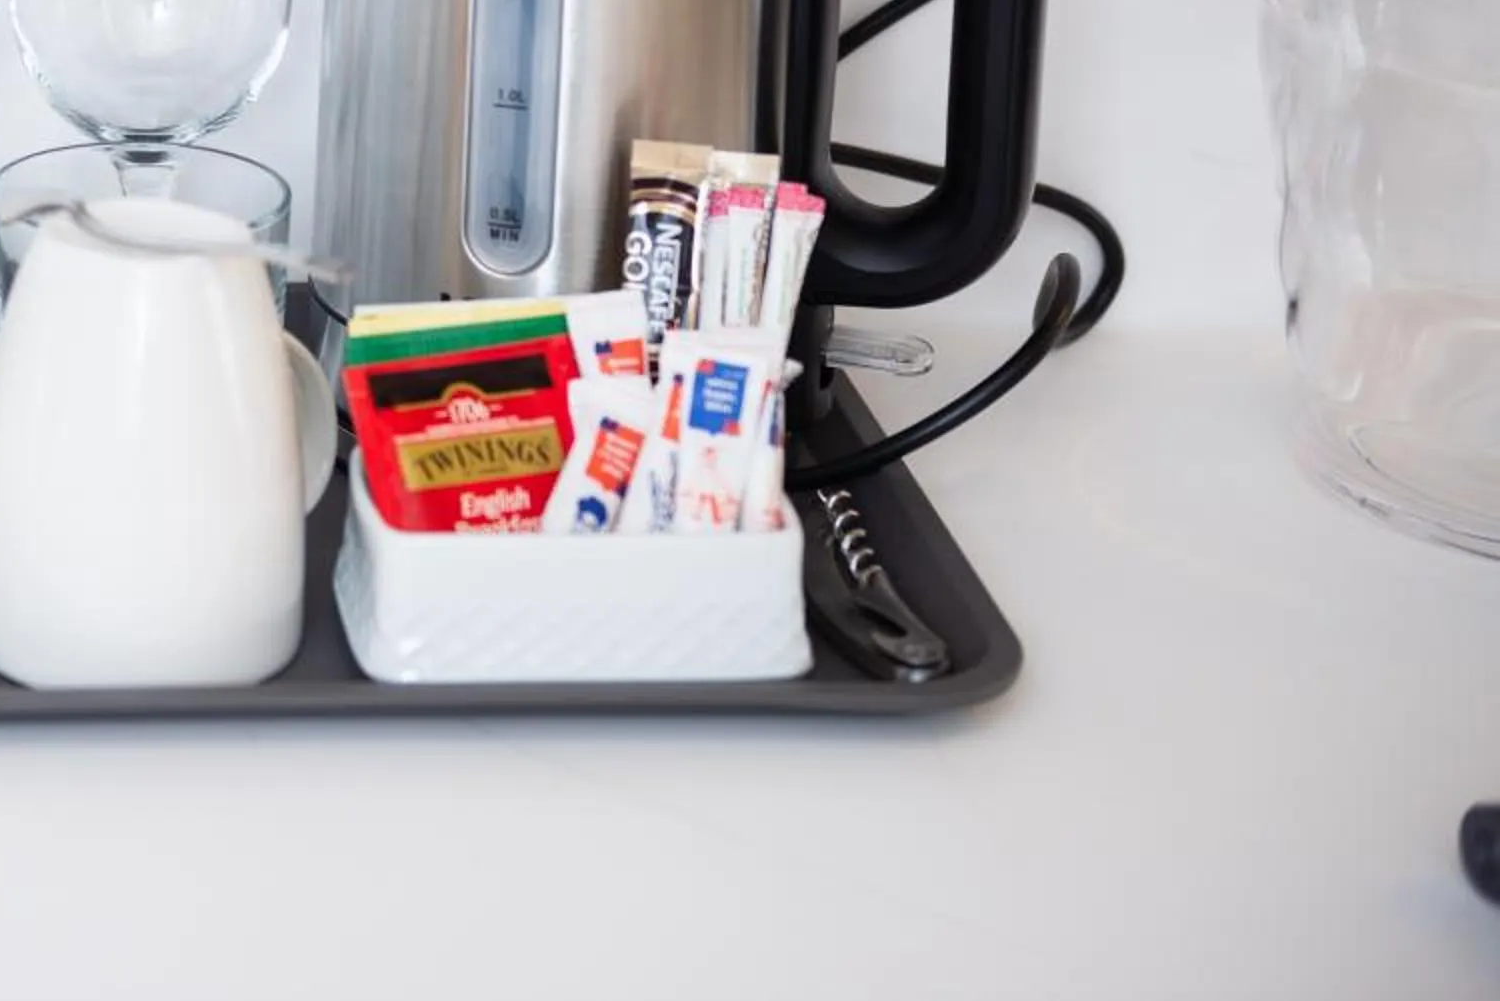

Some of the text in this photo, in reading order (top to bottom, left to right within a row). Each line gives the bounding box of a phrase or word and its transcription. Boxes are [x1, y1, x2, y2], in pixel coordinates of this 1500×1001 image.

[489, 228, 520, 242] MIN
[415, 434, 553, 483] TWININGS
[459, 485, 532, 520] English
